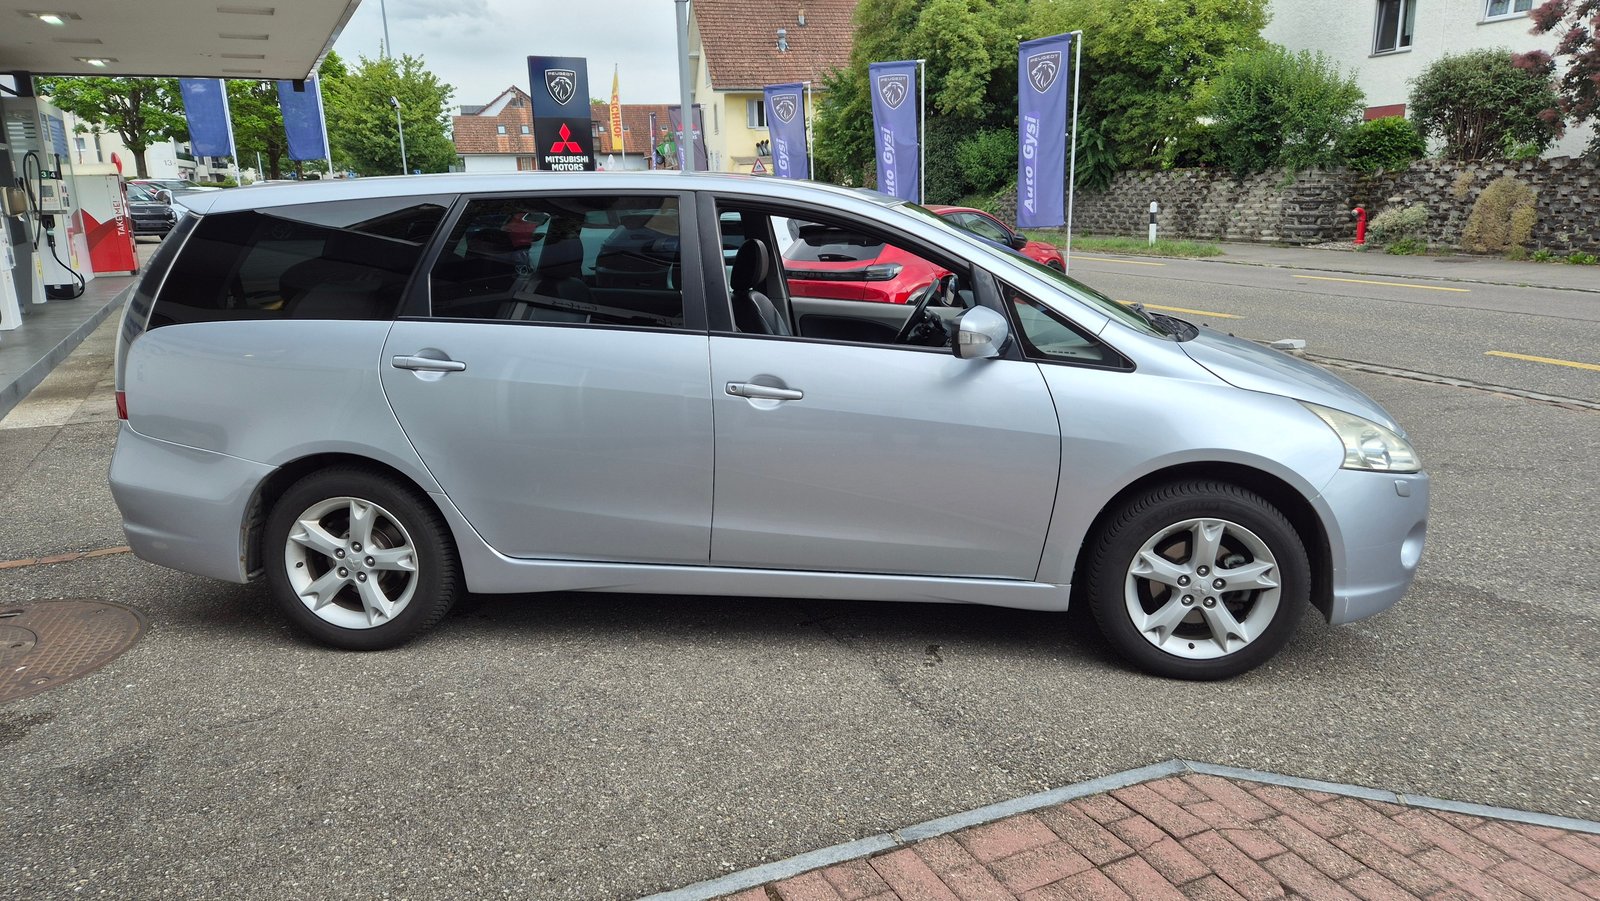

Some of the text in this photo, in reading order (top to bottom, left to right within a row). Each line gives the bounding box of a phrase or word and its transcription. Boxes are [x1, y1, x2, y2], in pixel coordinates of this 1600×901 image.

[1030, 54, 1059, 62] PEUGEOT
[545, 155, 589, 163] MITSUBISHI
[776, 138, 790, 170] Gysi
[881, 127, 896, 198] uto Gysi
[1023, 116, 1037, 213] Auto Gysi
[116, 216, 126, 236] TAKE
